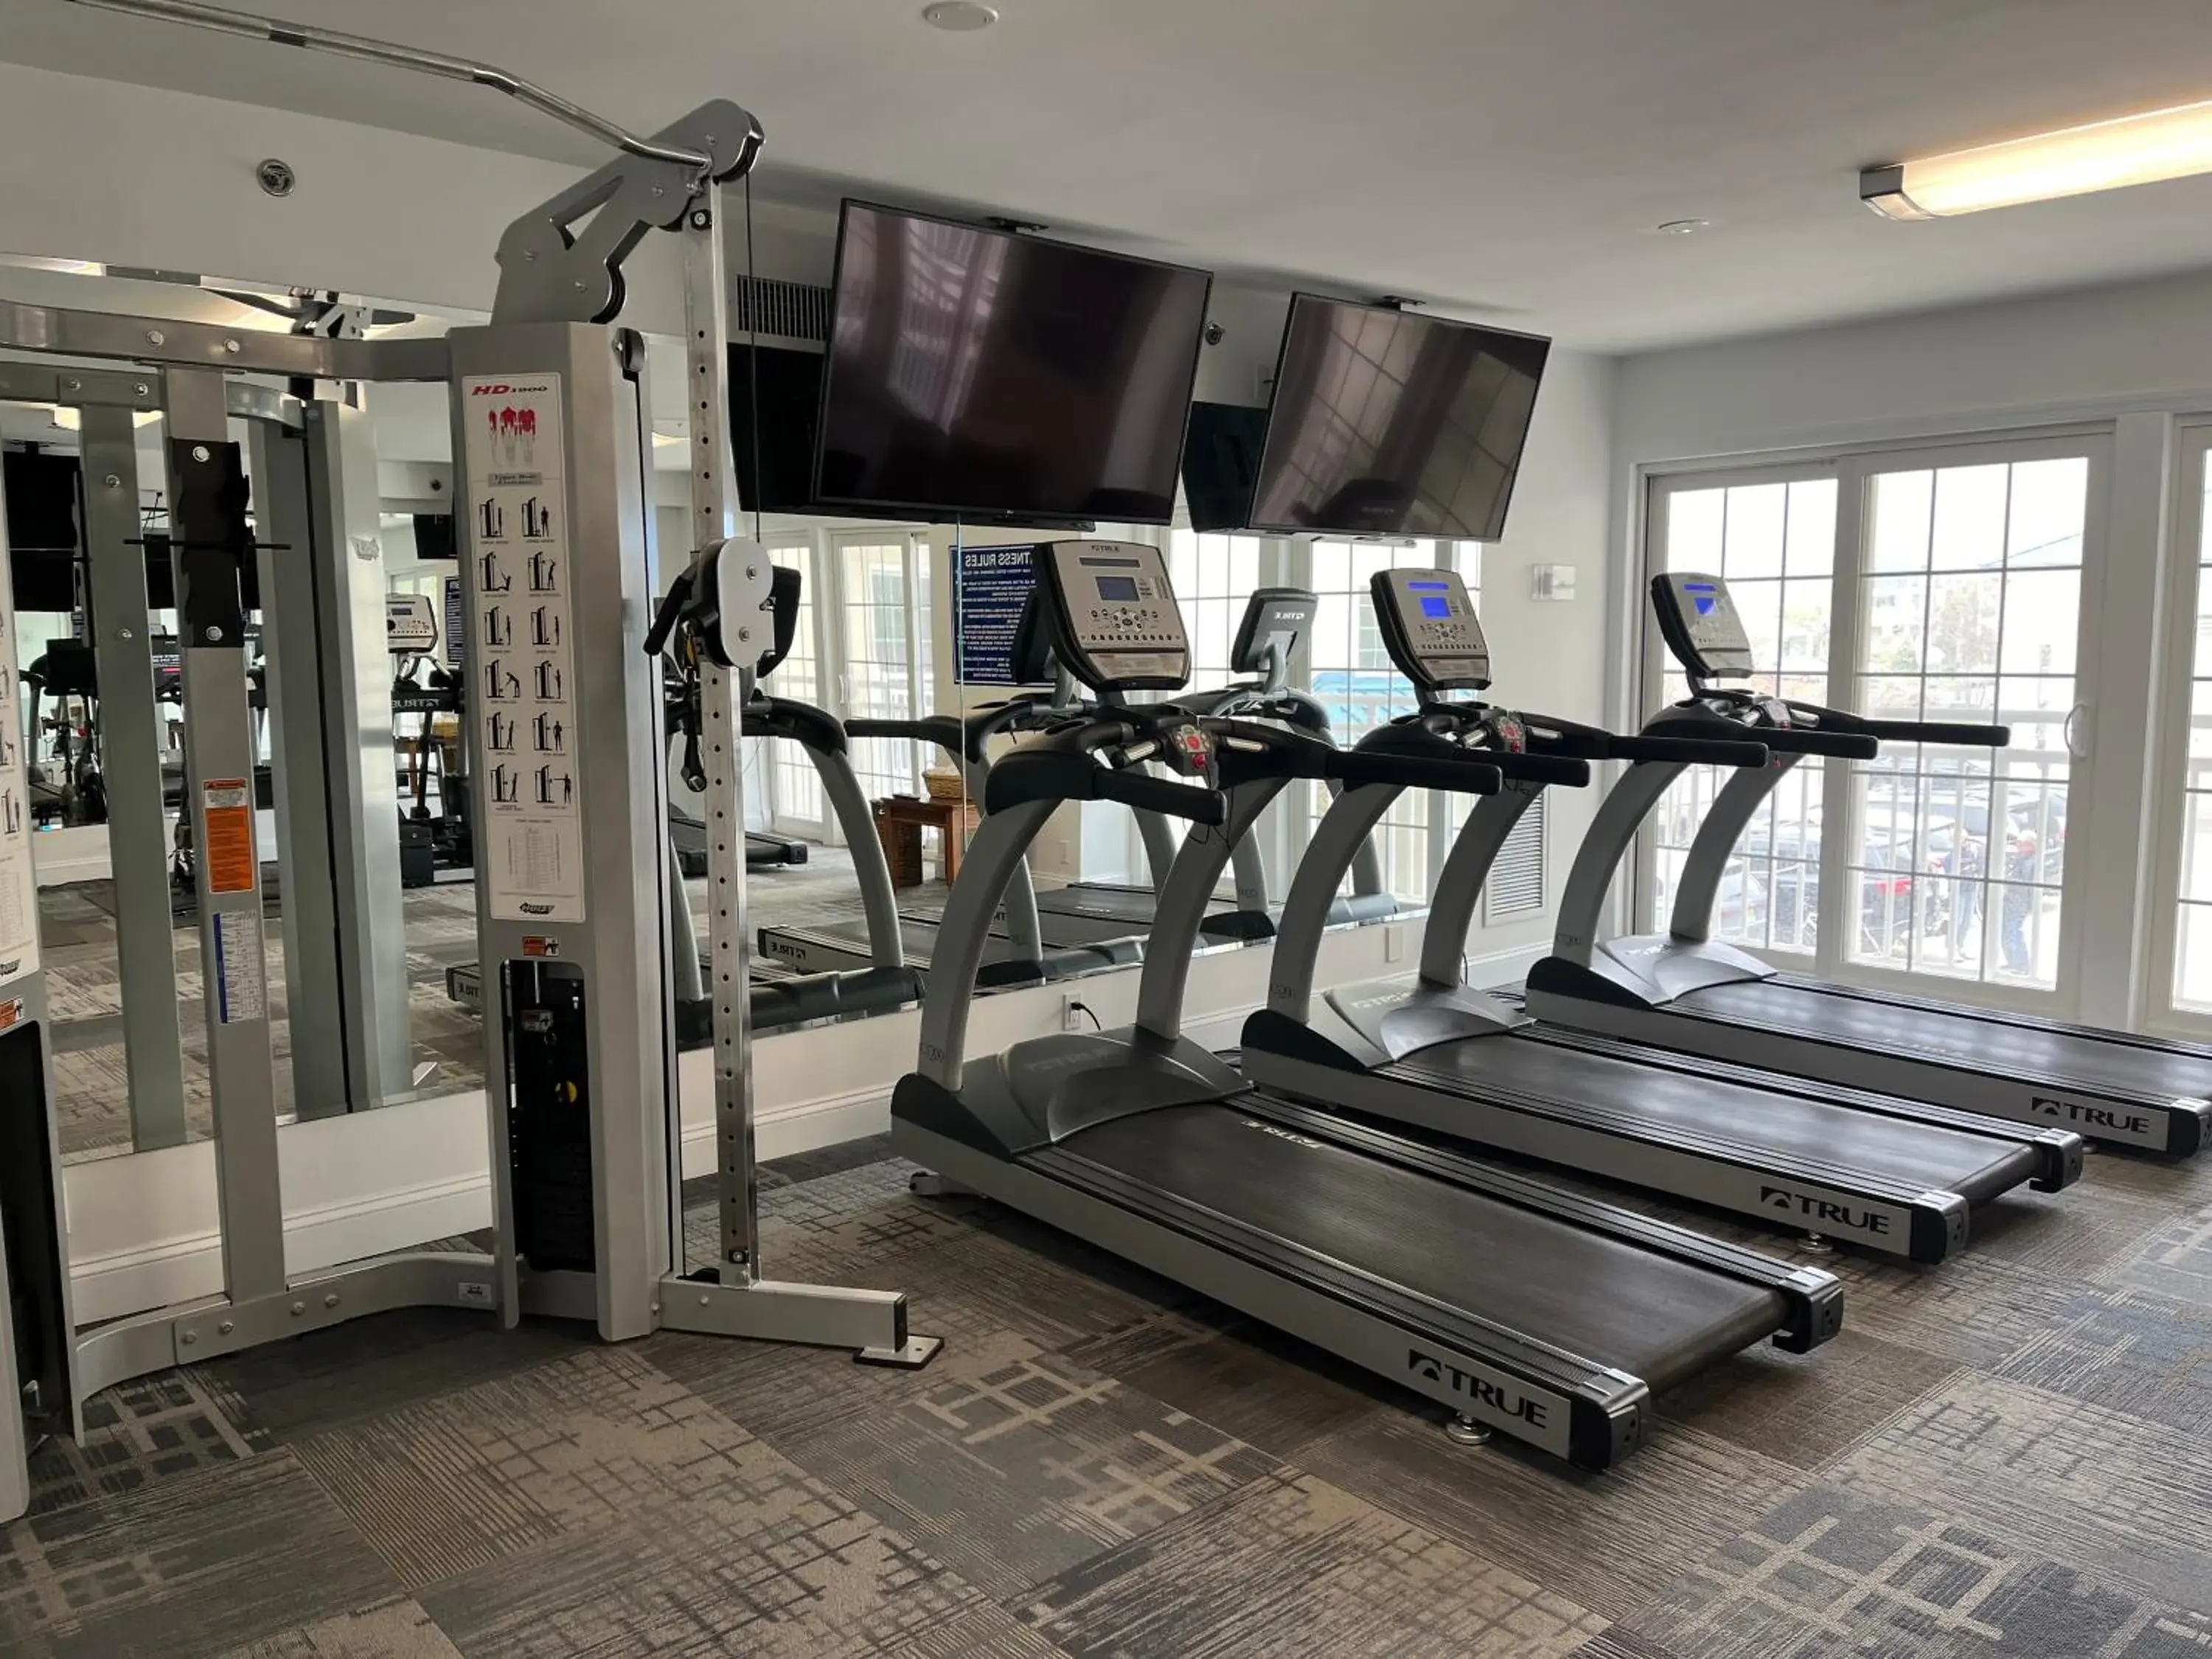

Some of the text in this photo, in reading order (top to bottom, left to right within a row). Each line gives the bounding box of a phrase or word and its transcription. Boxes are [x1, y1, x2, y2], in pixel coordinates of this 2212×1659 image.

[2062, 1104, 2149, 1133] TRUE
[1795, 1194, 1890, 1235] TRUE
[1444, 1363, 1547, 1429] TRUE
